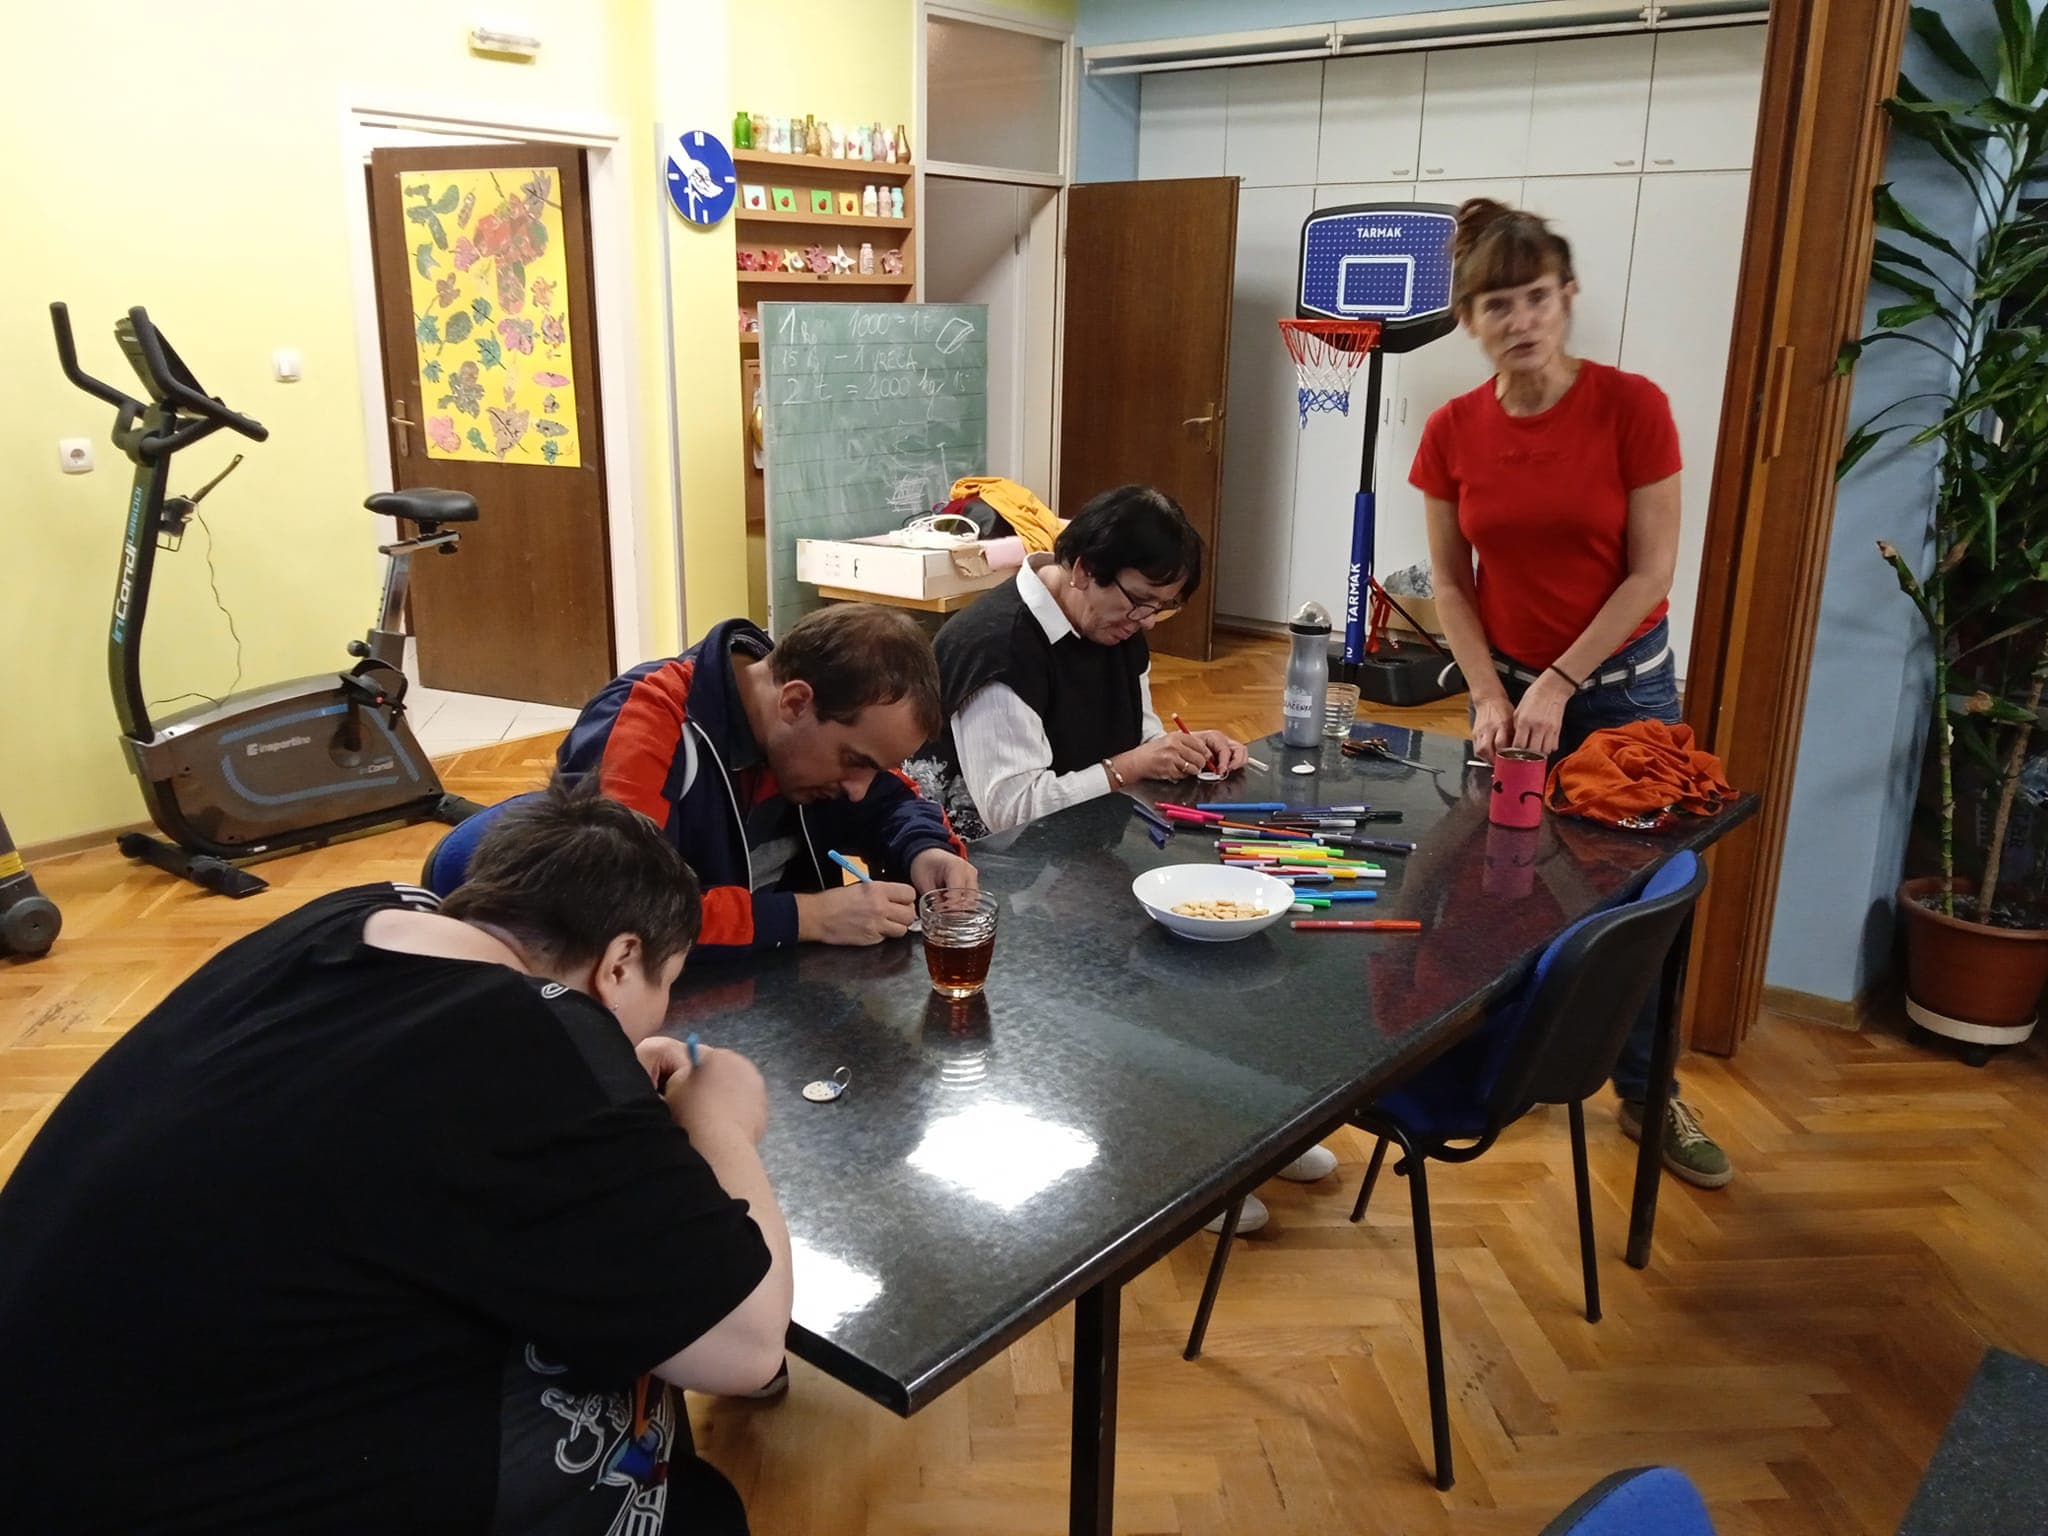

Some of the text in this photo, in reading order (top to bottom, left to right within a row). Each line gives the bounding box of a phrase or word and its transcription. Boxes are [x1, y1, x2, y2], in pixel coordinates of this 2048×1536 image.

[1356, 227, 1402, 239] TARMAK
[849, 309, 890, 337] 1000
[1347, 563, 1361, 624] TARMAK
